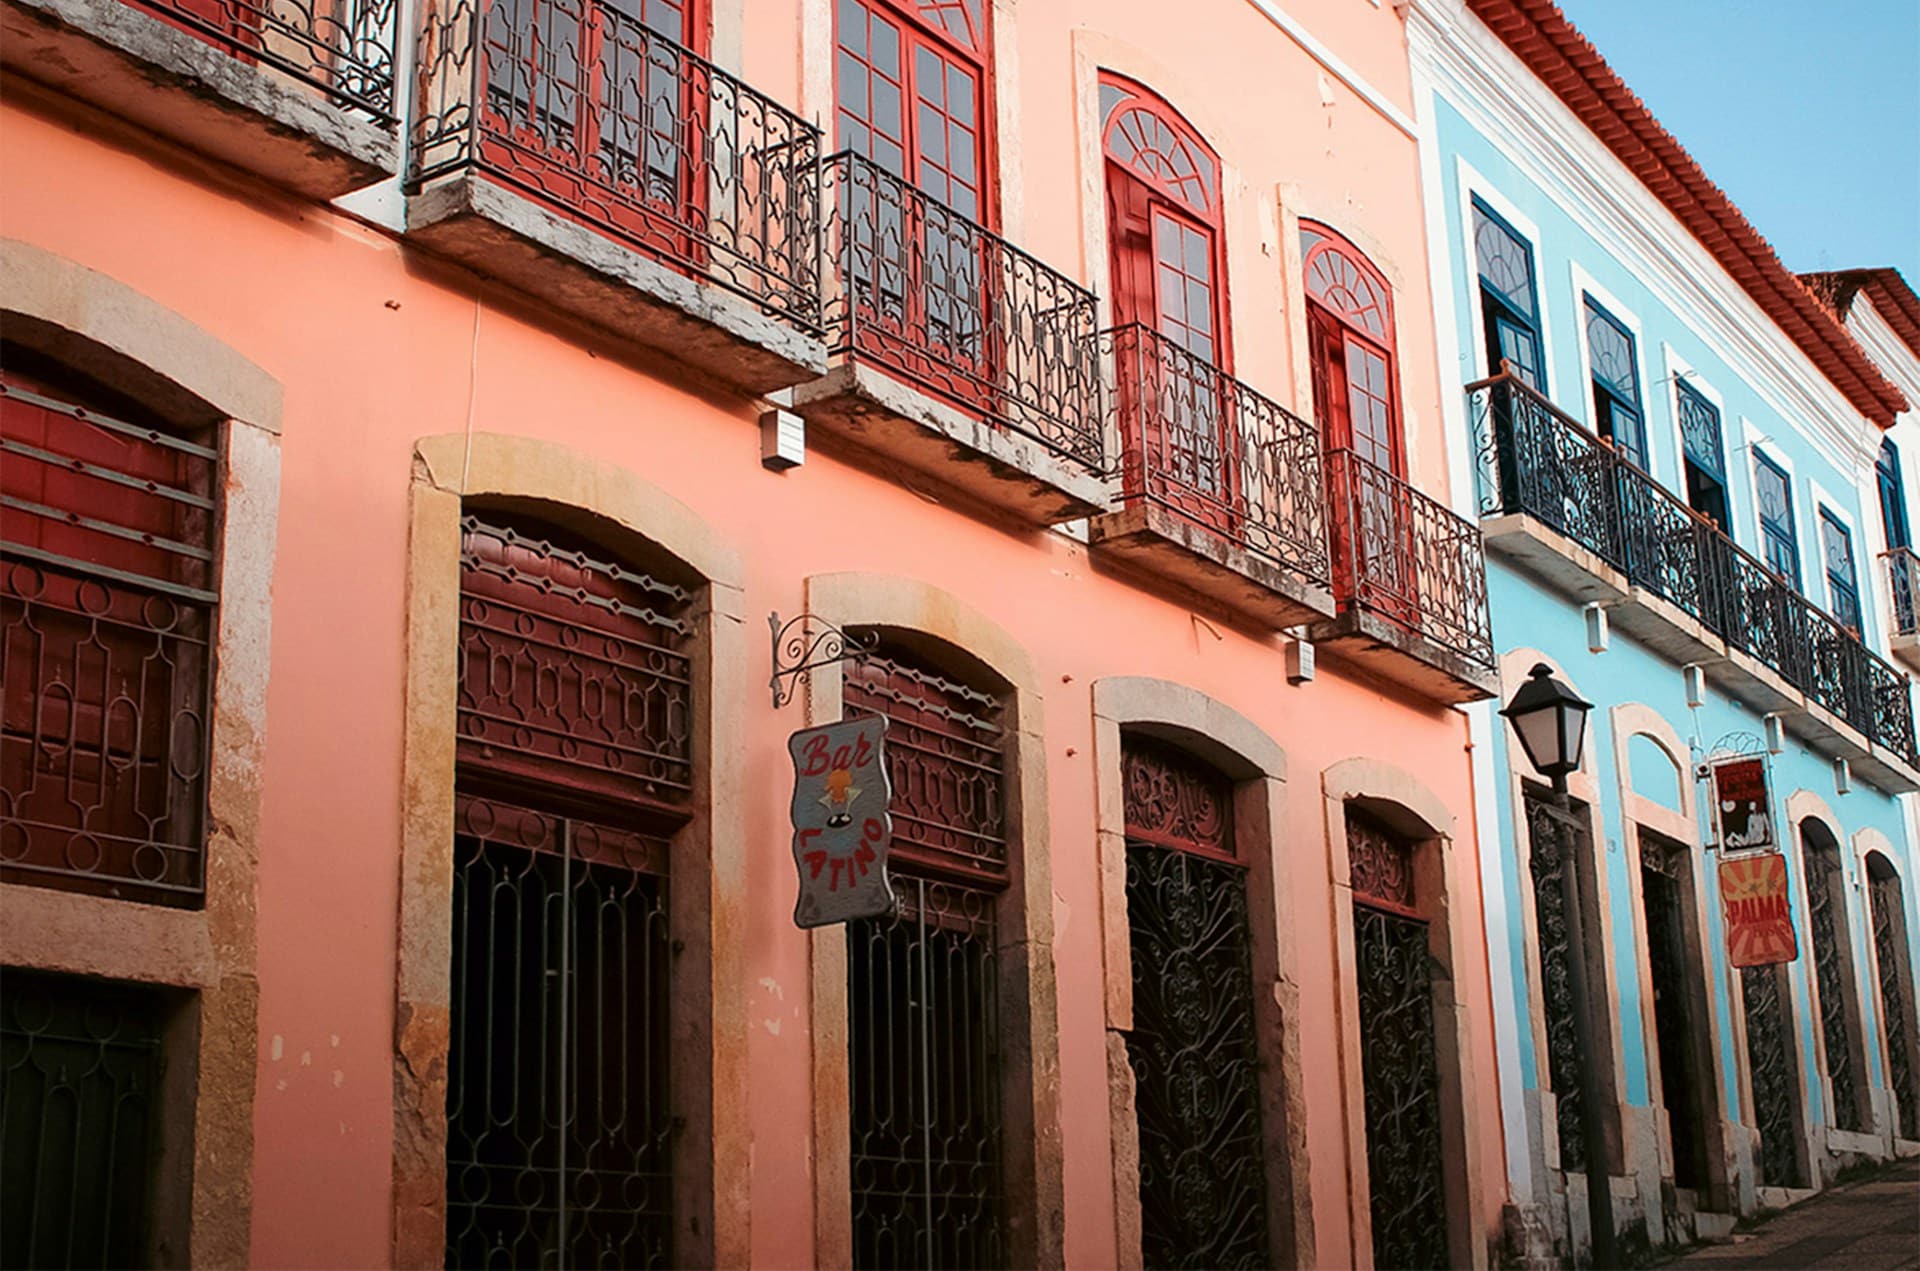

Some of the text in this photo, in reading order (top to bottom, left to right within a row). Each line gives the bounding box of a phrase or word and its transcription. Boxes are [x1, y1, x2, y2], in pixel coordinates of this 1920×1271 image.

[801, 732, 873, 776] Bar
[800, 818, 883, 892] LATINO
[1728, 894, 1788, 926] PALMA
